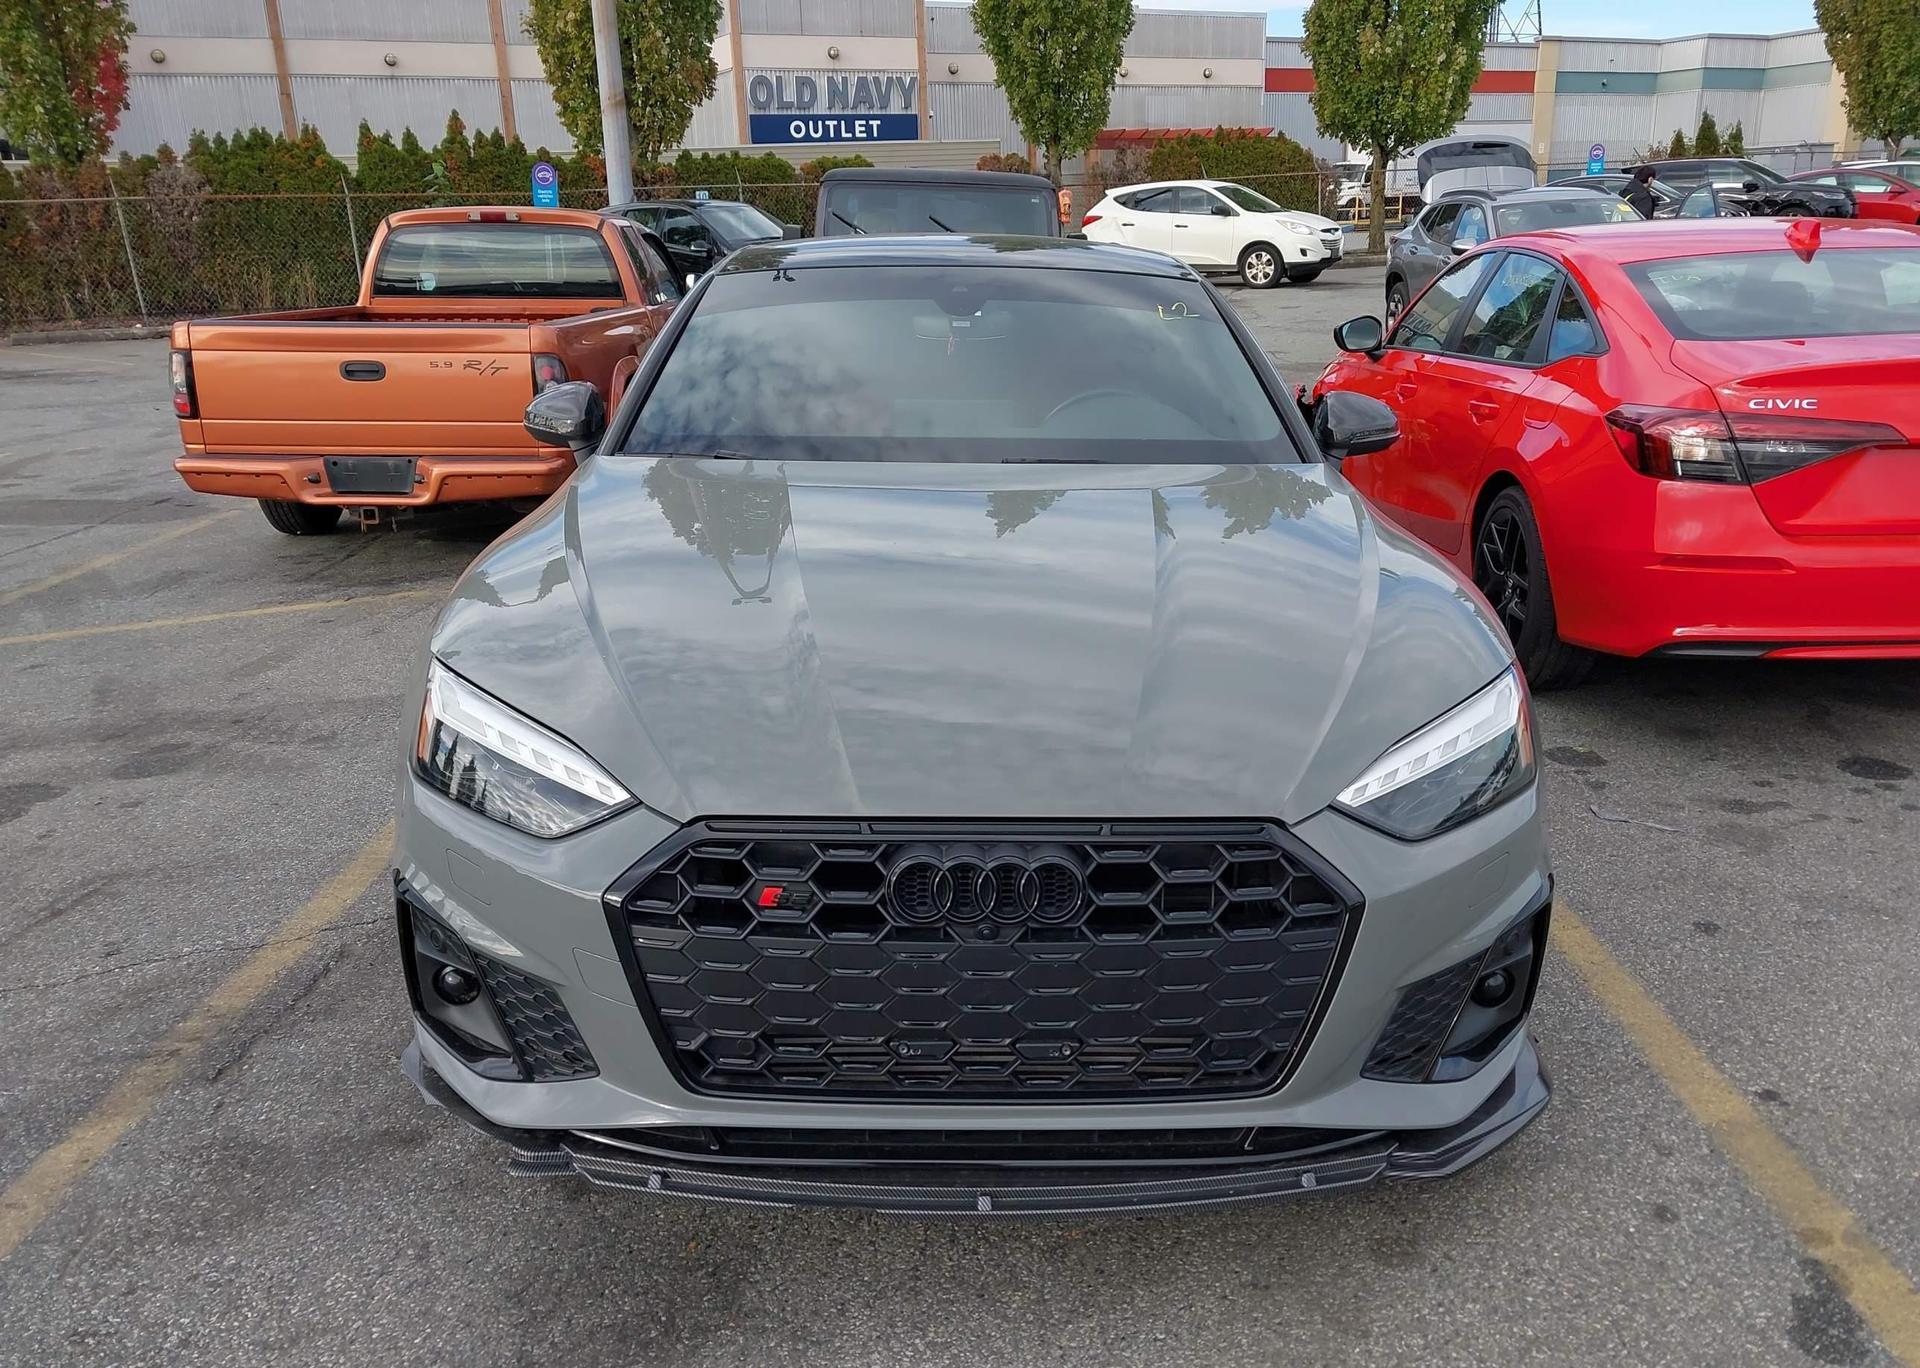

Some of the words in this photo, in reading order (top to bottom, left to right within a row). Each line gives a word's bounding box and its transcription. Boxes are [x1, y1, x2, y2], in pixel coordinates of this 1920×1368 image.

[749, 75, 818, 110] OLD
[826, 76, 918, 110] NAVY
[789, 120, 881, 139] OUTLET
[429, 361, 453, 369] 5.9
[463, 359, 509, 377] R/T
[1748, 398, 1818, 409] CIVIC
